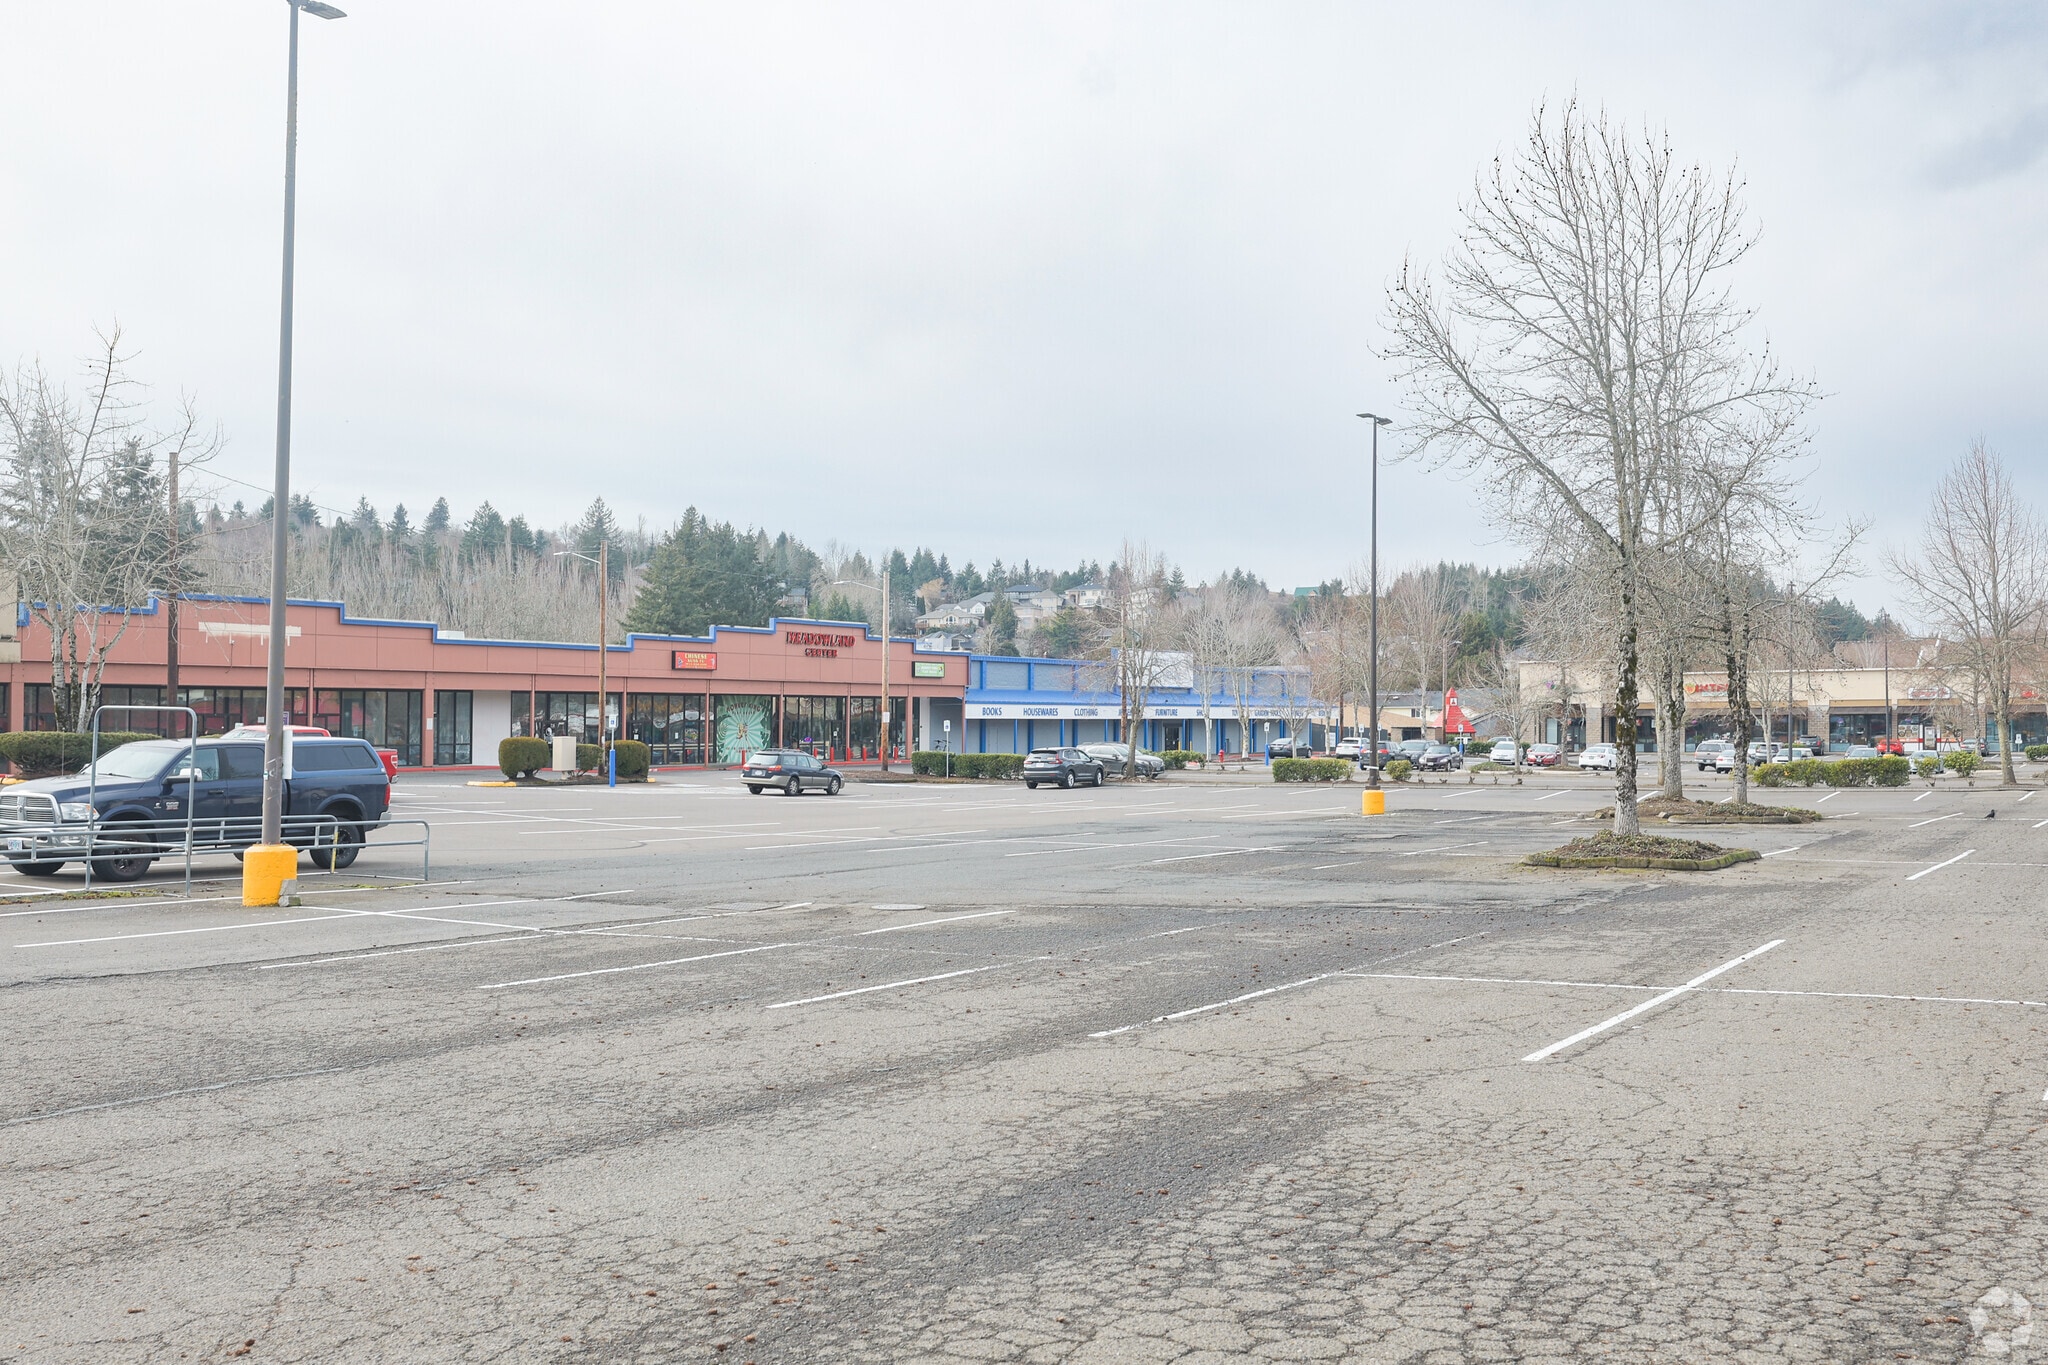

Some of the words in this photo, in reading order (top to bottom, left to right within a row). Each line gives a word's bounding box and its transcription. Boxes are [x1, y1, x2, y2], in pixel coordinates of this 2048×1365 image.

[786, 631, 856, 647] MEADOWLAND
[805, 648, 838, 658] CENTER
[982, 707, 1002, 716] BOOKS
[1023, 707, 1058, 716] HOUSEWARES
[1074, 708, 1098, 716] CLOTHING
